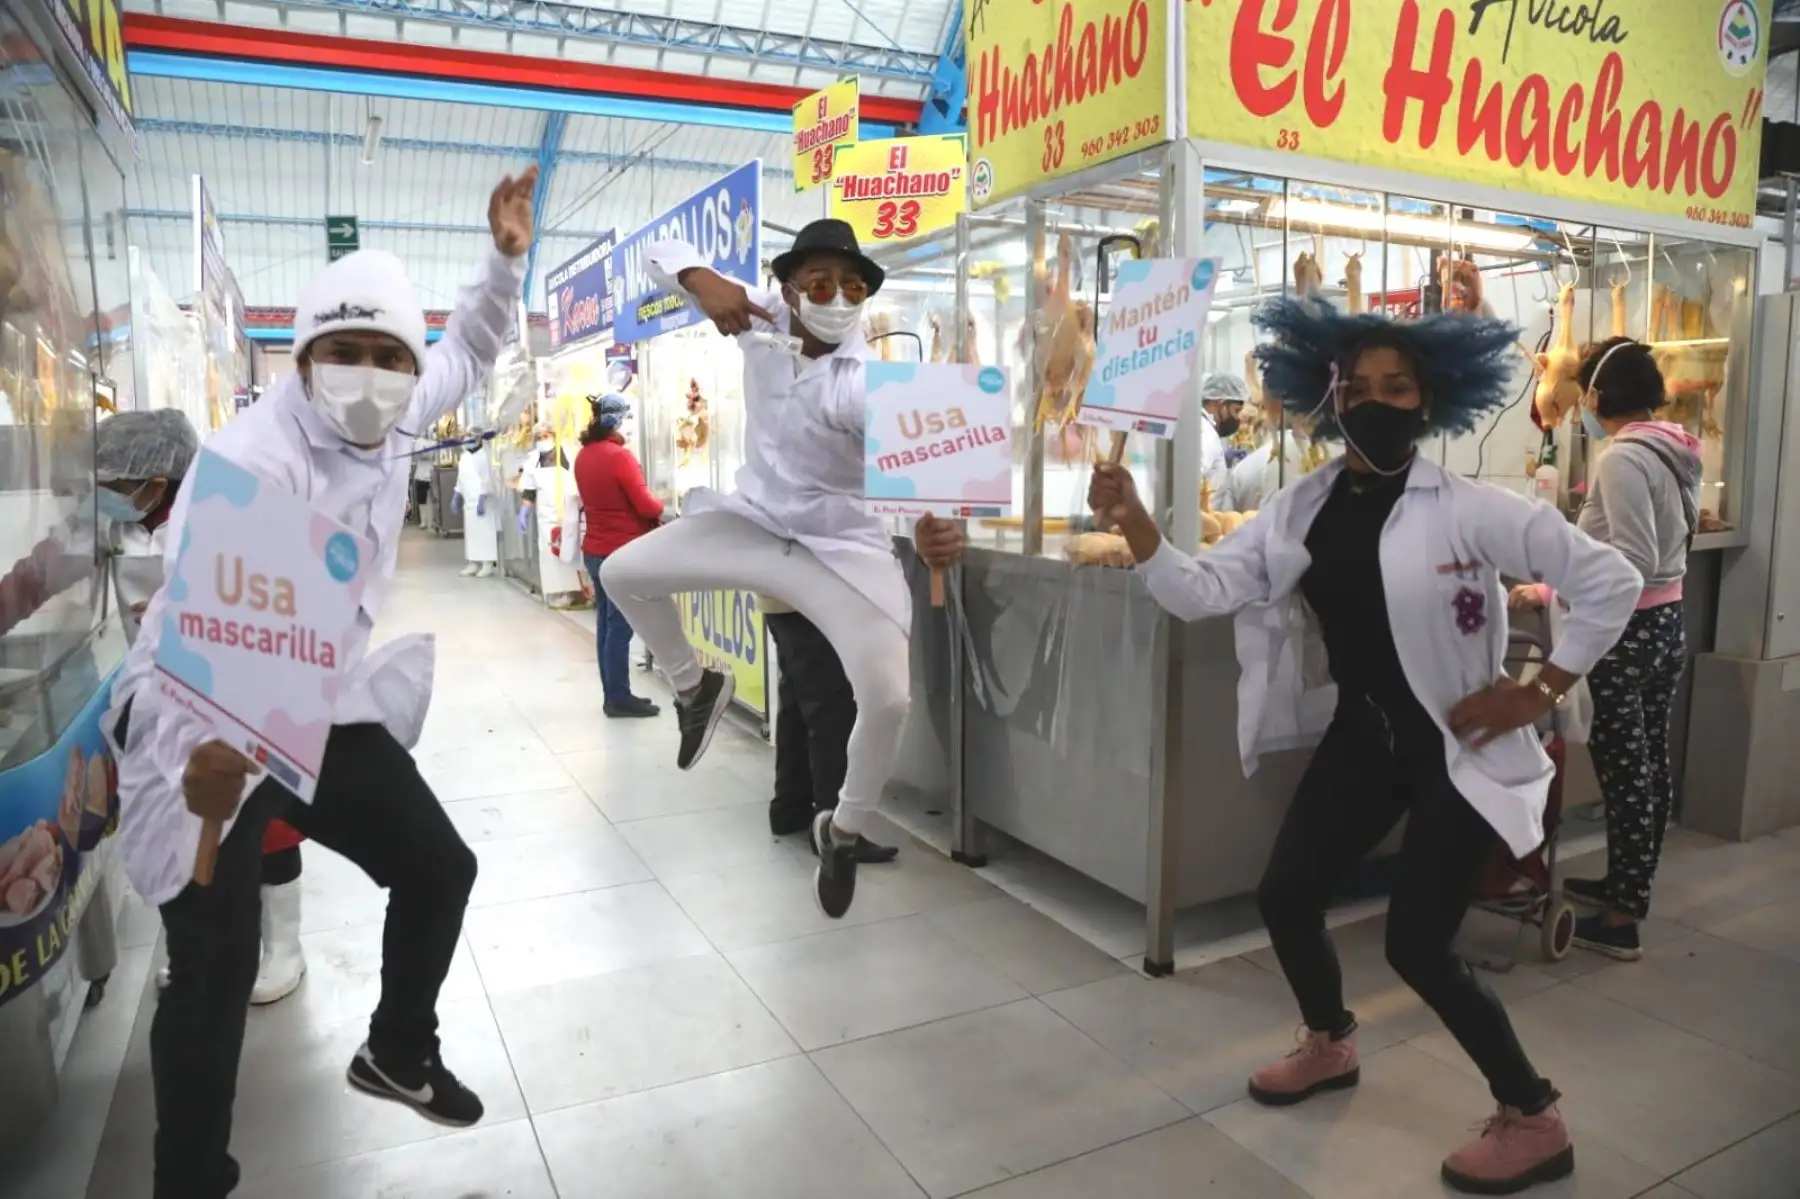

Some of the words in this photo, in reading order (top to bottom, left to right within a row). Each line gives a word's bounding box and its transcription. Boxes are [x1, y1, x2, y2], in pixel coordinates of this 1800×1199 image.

[817, 96, 828, 122] El
[889, 145, 909, 170] El
[1041, 119, 1066, 173] 33
[1080, 135, 1104, 160] 960
[1106, 126, 1130, 152] 342
[1133, 114, 1161, 144] 303
[1275, 127, 1301, 152] 33
[811, 143, 834, 184] 33
[872, 199, 921, 239] 33
[1109, 283, 1191, 336] Mantén
[1101, 328, 1196, 383] distancia
[1138, 325, 1159, 348] tu
[896, 405, 968, 441] Usa
[876, 424, 1007, 473] mascarilla
[214, 552, 297, 619] Usa
[179, 610, 337, 669] mascarilla
[691, 589, 756, 665] POLLOS
